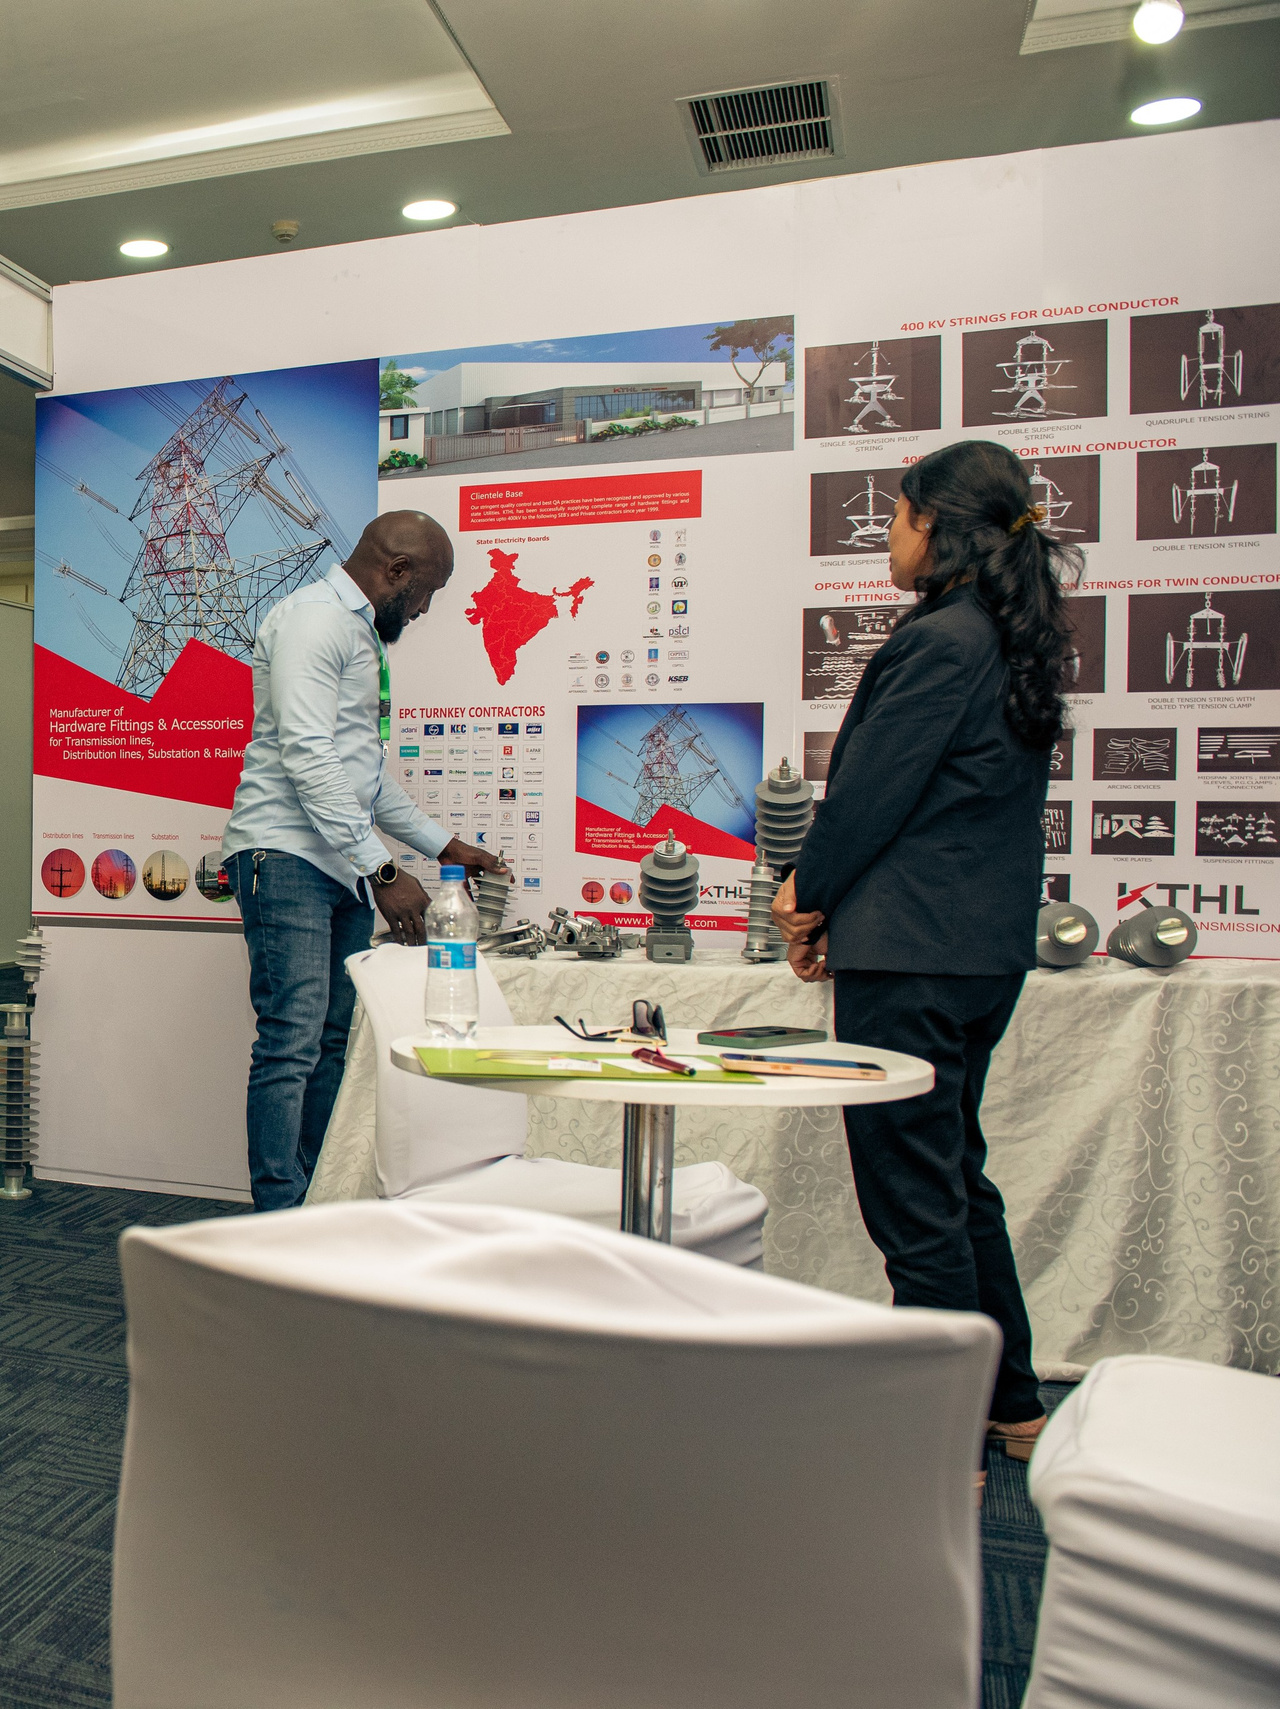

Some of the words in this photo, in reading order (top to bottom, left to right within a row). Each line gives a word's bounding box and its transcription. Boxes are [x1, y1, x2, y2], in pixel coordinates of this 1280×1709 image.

[900, 322, 924, 332] 400
[928, 320, 946, 329] KV
[950, 313, 1006, 327] STRINGS
[1010, 310, 1038, 320] FOR
[1042, 306, 1084, 317] QUAD
[1088, 296, 1180, 313] CONDUCTOR
[1146, 417, 1195, 427] QUADRUPLE
[1198, 414, 1235, 423] TENSION
[1238, 411, 1270, 420] STRING
[998, 428, 1030, 436] DOUBLE
[1032, 424, 1082, 434] SUSPENSION
[1024, 433, 1055, 441] STRING
[820, 440, 847, 449] SINGLE
[848, 438, 896, 447] SUSPENSION
[855, 444, 884, 453] STRING
[1044, 445, 1082, 455] TWIN
[1086, 438, 1177, 453] CONDUCTOR
[470, 491, 503, 500] Clientele
[505, 490, 524, 498] Base
[1152, 544, 1186, 552] DOUBLE
[1228, 540, 1260, 548] STRING
[820, 560, 846, 568] SINGLE
[848, 558, 889, 566] SUSPENSIO
[814, 582, 855, 591] OPGW
[858, 580, 894, 589] HARD
[1083, 579, 1134, 591] STRINGS
[1137, 578, 1163, 588] FOR
[1166, 577, 1199, 586] TWIN
[845, 592, 900, 603] FITTINGS
[50, 707, 111, 718] Manufacturer
[114, 706, 125, 717] of
[399, 708, 417, 719] EPC
[420, 707, 466, 718] TURNKEY
[469, 706, 546, 718] CONTRACTORS
[50, 721, 106, 733] Hardware
[110, 719, 154, 735] Fittings
[158, 719, 167, 731] &
[171, 717, 244, 730] Accessories
[450, 724, 467, 733] KEC
[49, 736, 63, 747] for
[65, 735, 127, 746] Transmission
[129, 735, 155, 747] lines,
[63, 749, 117, 760] Distribution
[119, 749, 145, 761] lines,
[148, 748, 200, 759] Substation
[204, 748, 212, 759] &
[215, 748, 246, 758] Railwa
[526, 811, 539, 819] BNC
[700, 885, 747, 899] KTHL
[1117, 881, 1260, 915] KTHL
[1193, 921, 1280, 933] ANSMISSION
